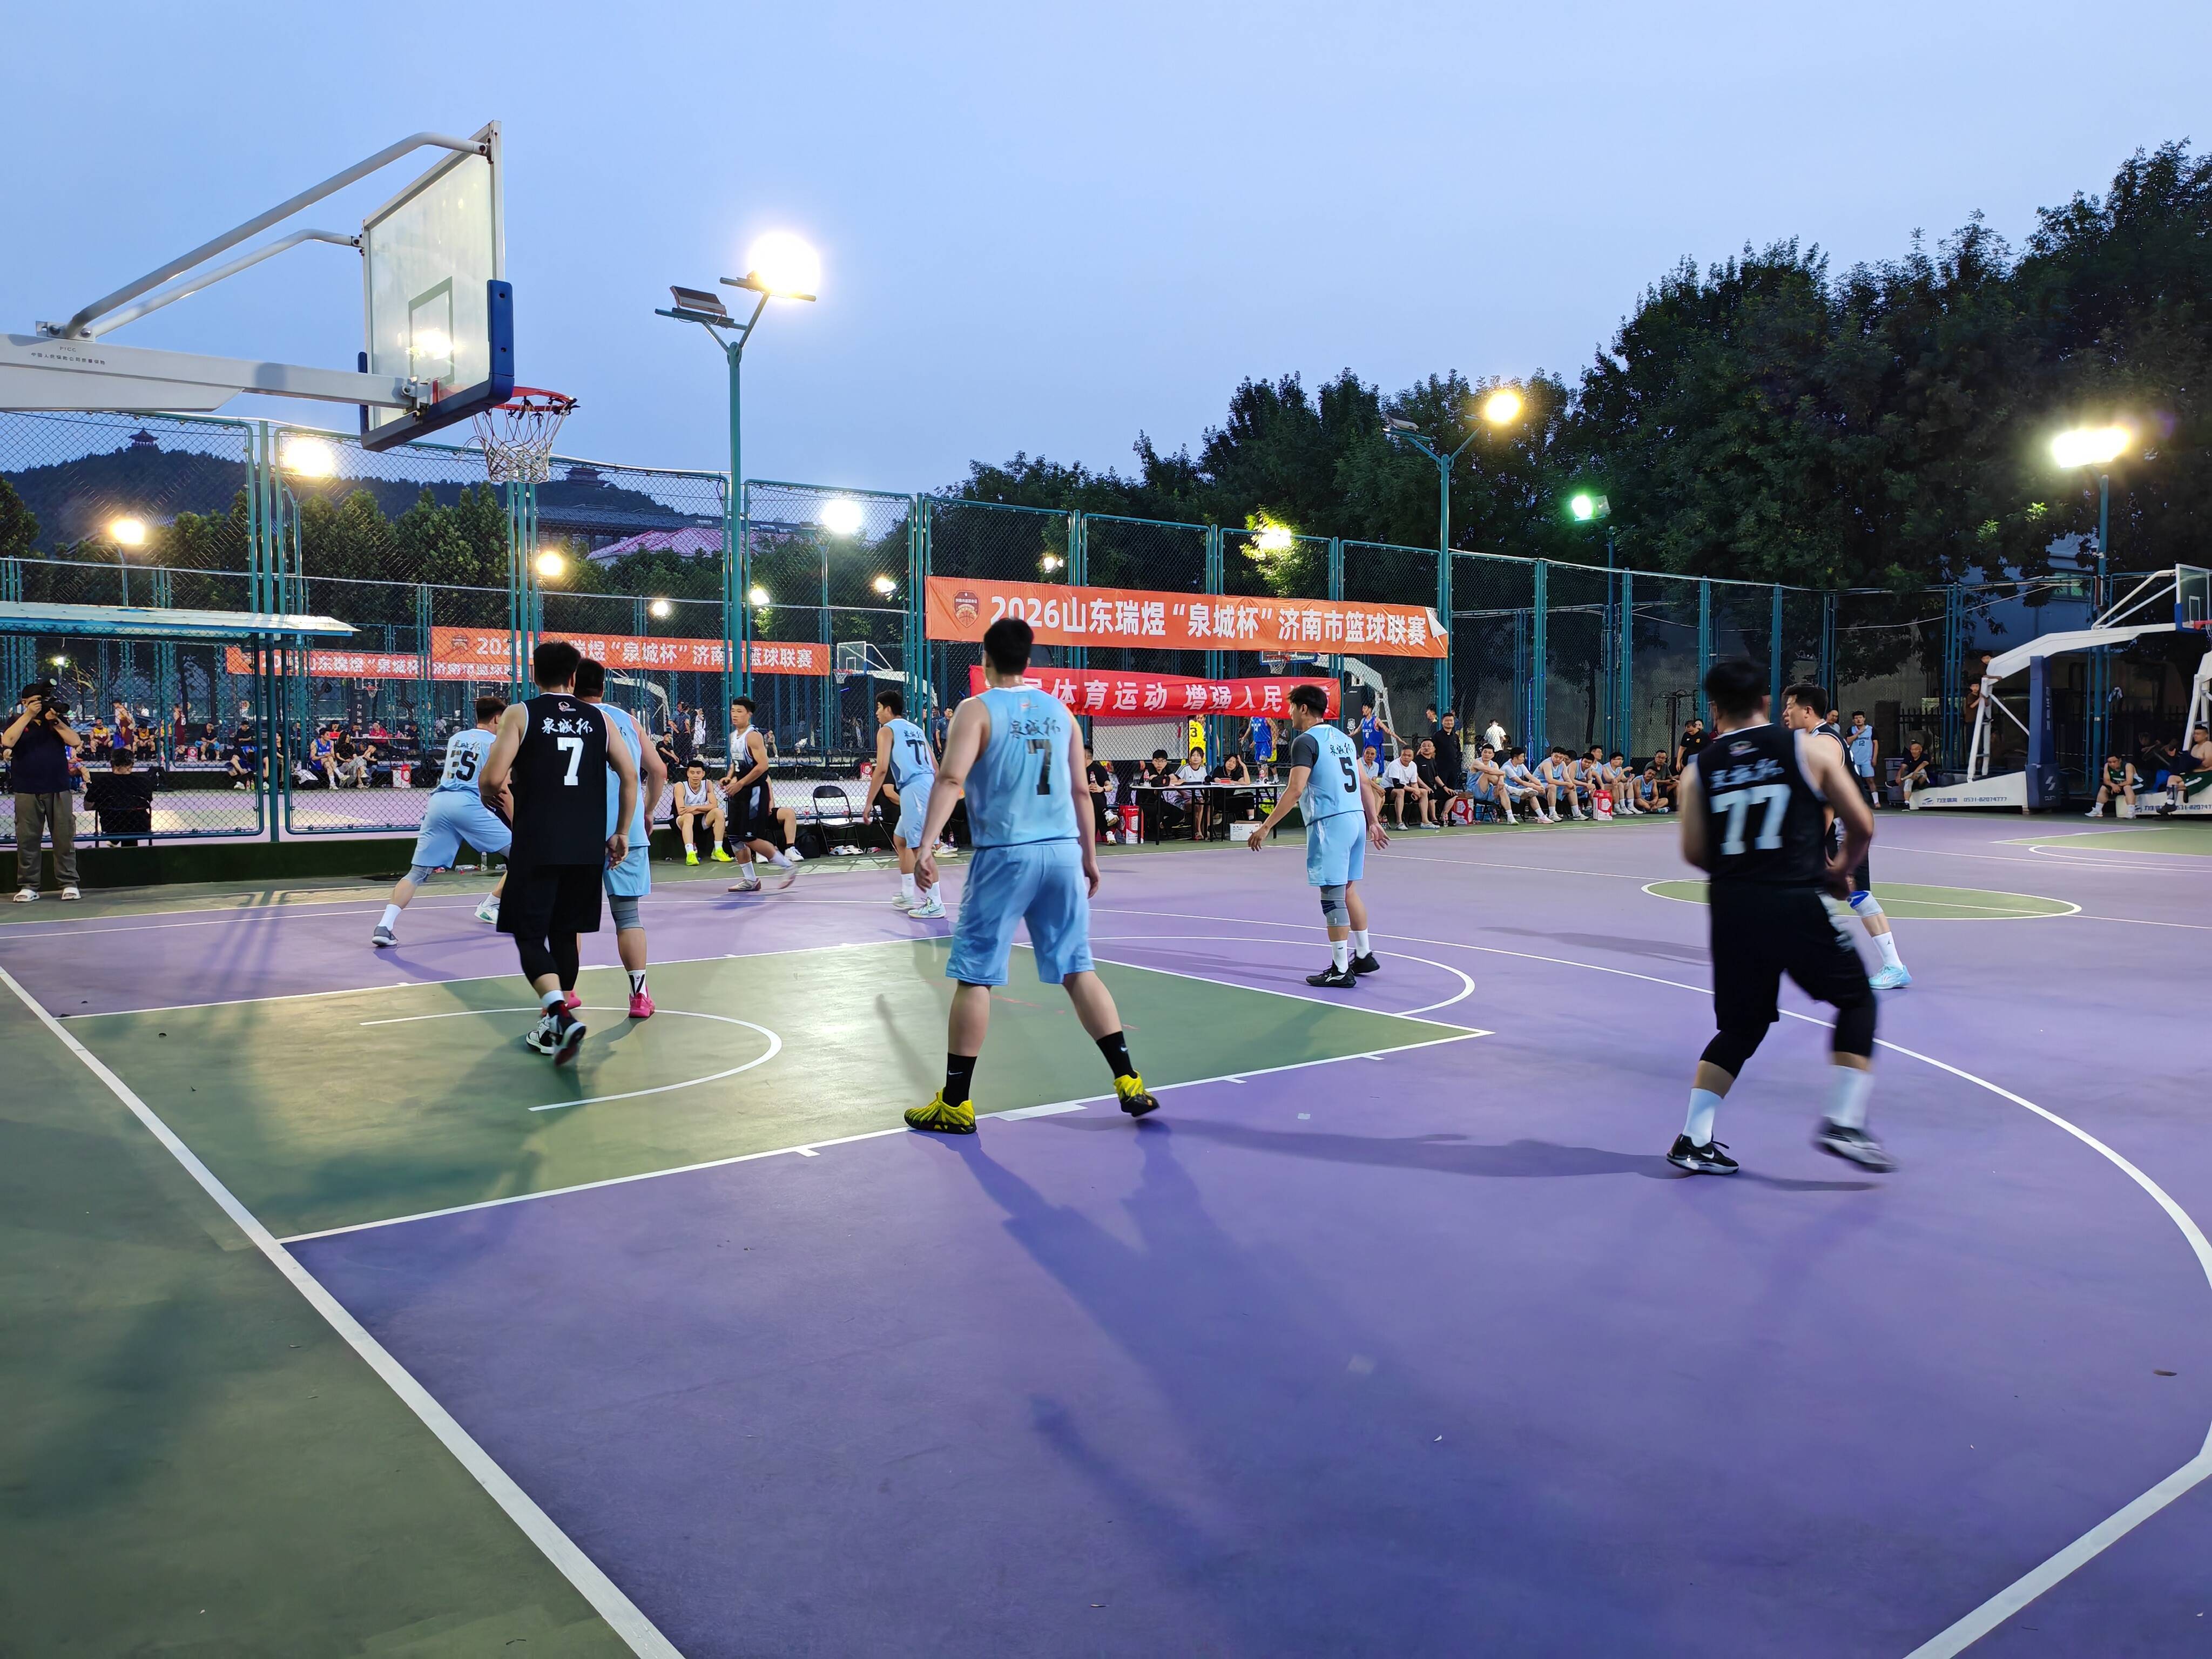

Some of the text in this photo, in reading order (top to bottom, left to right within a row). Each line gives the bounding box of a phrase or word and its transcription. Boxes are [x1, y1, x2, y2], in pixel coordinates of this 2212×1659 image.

[985, 678, 1331, 713] 体育运动 增强人民
[541, 718, 593, 735] 泉城杯
[1010, 717, 1061, 739] 泉城杯
[557, 737, 584, 786] 7
[905, 739, 929, 765] 77
[1027, 739, 1052, 795] 7
[1339, 757, 1357, 793] 5
[1709, 784, 1792, 855] 77
